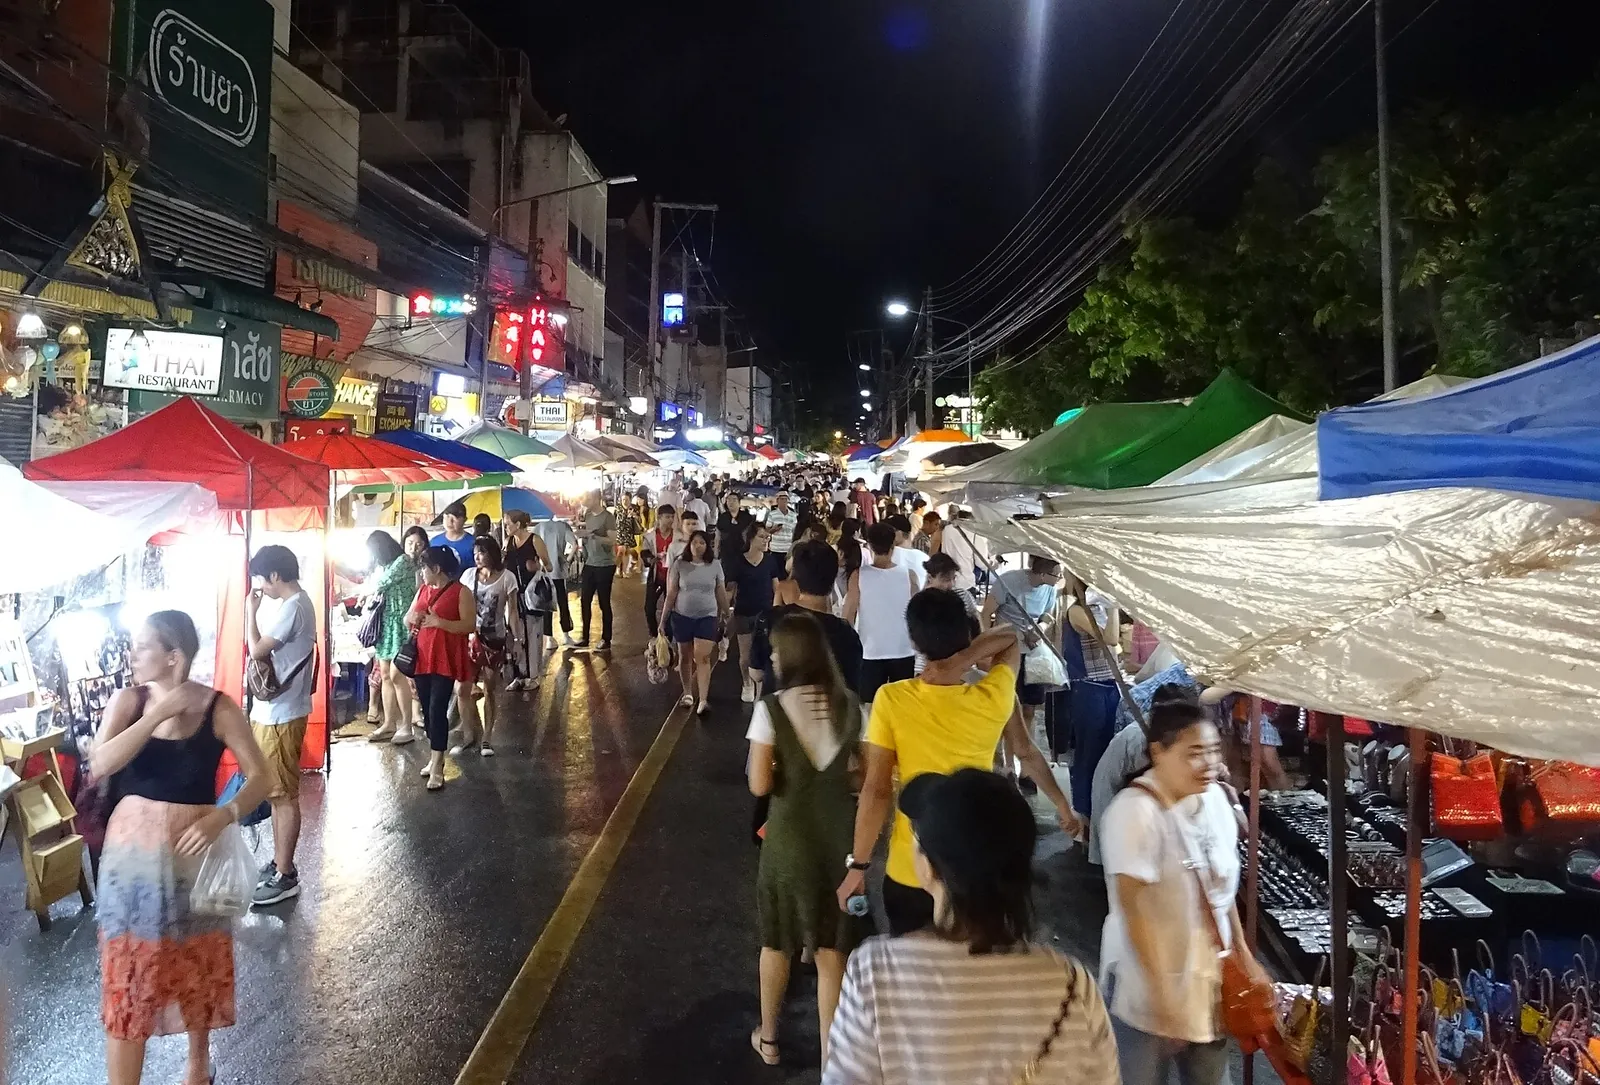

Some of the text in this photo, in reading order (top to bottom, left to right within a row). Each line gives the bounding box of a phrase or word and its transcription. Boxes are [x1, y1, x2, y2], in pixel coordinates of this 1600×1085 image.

[168, 33, 244, 123] ร้านยา
[149, 353, 206, 377] THAI
[138, 374, 216, 390] RESTAURANT
[334, 382, 378, 407] HANGE
[540, 406, 561, 415] THAI
